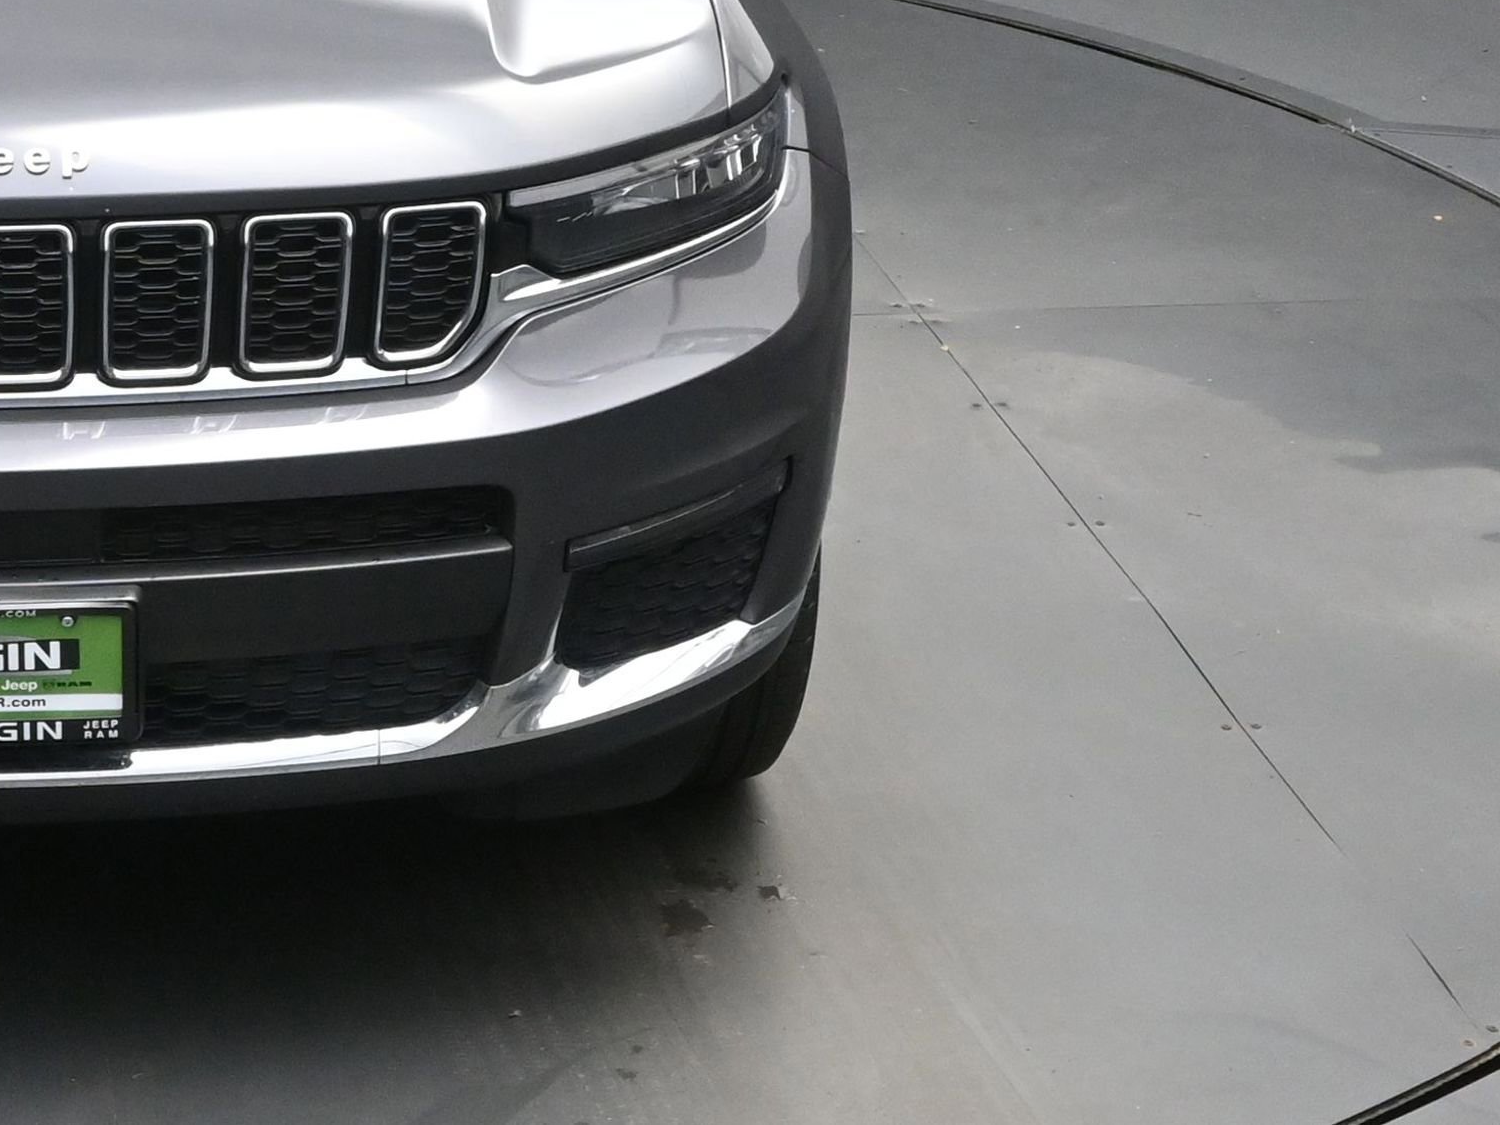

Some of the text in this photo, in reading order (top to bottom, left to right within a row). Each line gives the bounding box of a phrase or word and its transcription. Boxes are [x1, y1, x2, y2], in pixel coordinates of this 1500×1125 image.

[0, 679, 38, 692] Jeep
[83, 719, 119, 729] JEEP
[84, 730, 119, 739] RAM
